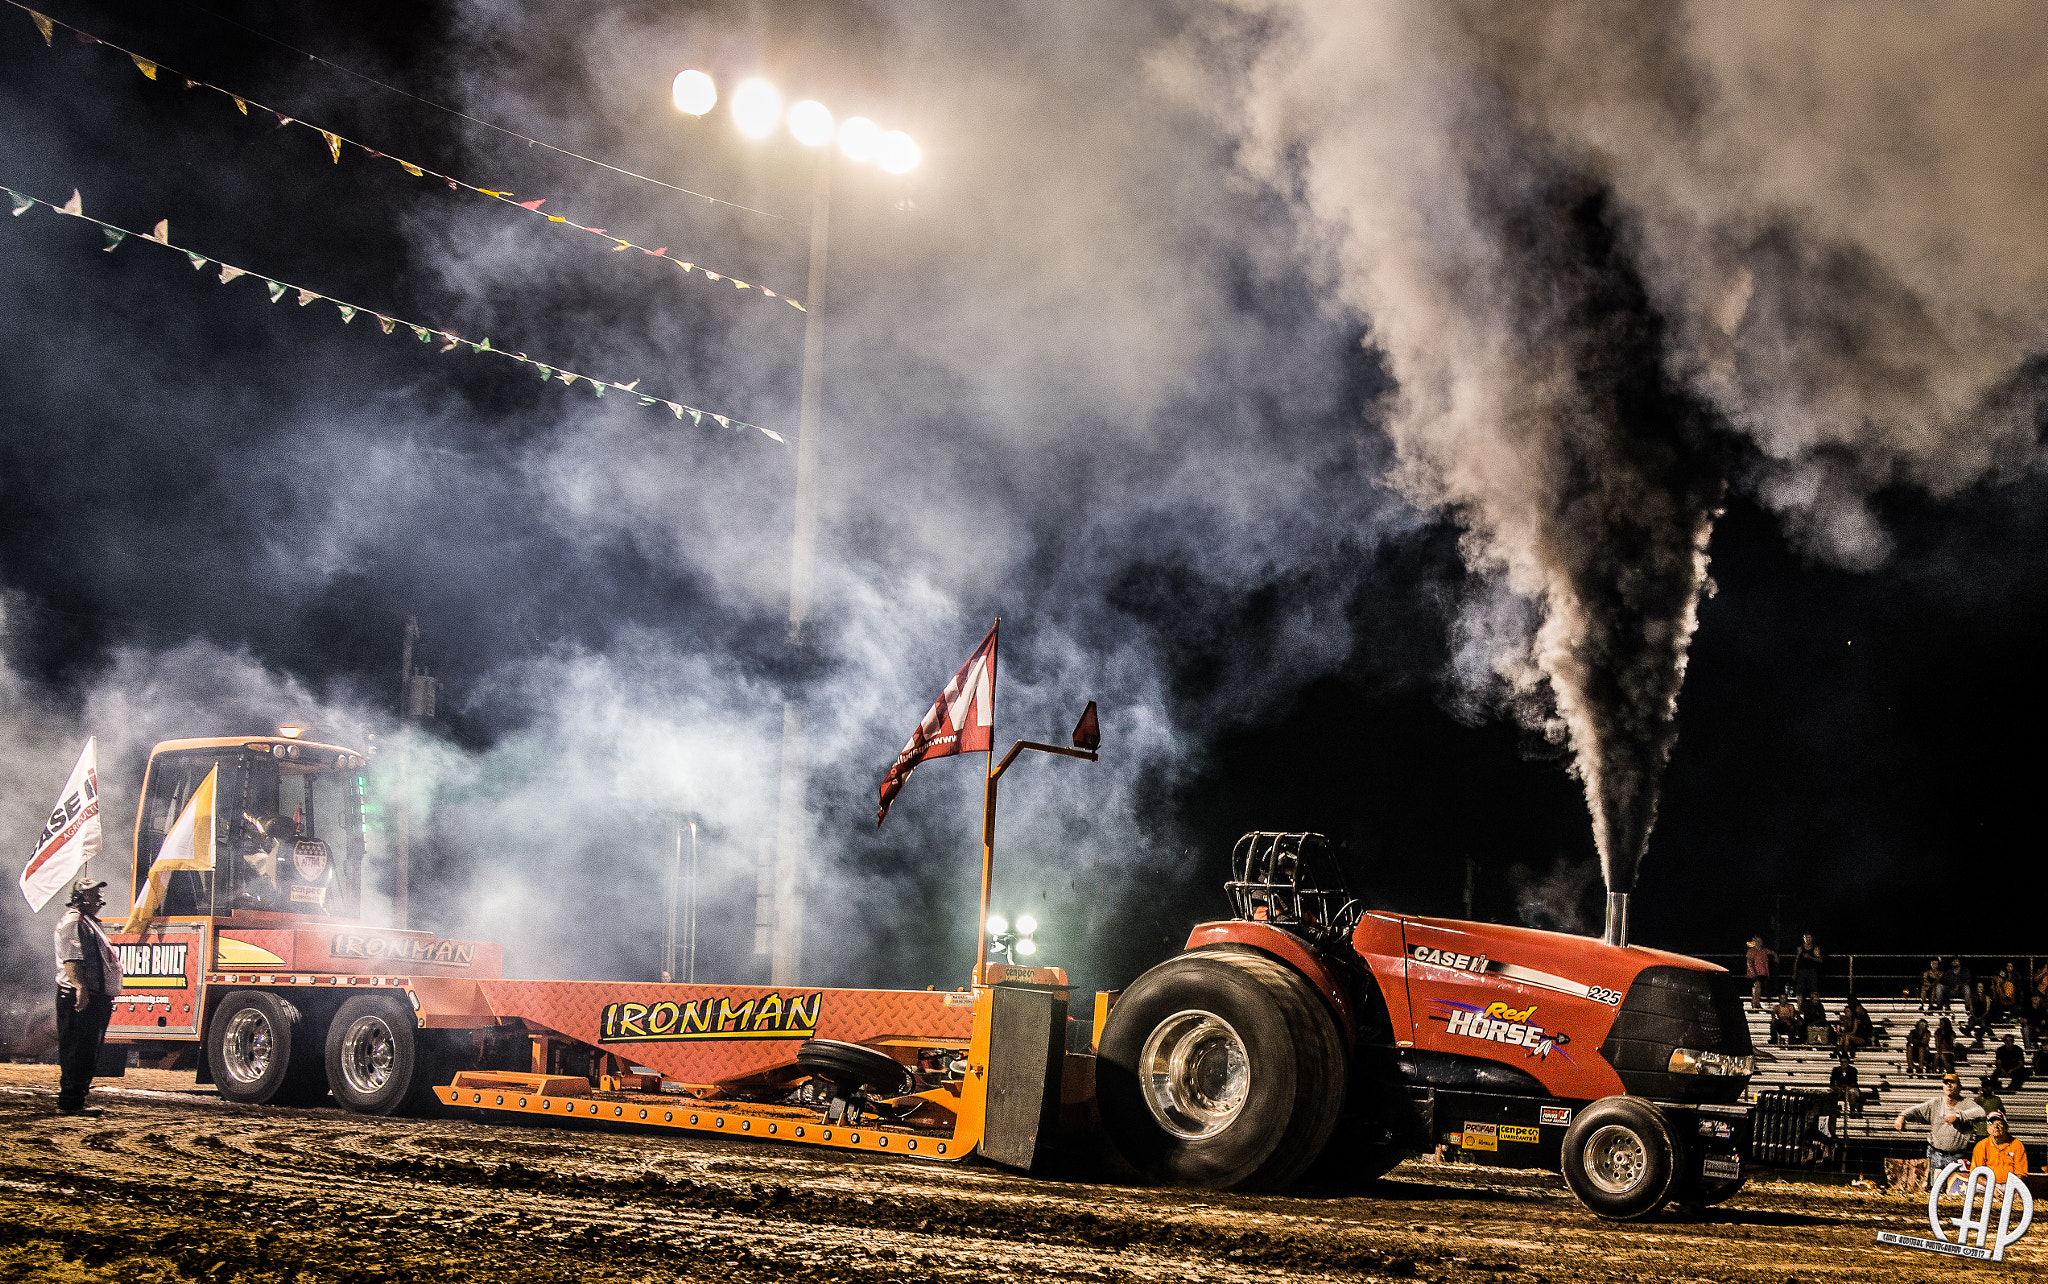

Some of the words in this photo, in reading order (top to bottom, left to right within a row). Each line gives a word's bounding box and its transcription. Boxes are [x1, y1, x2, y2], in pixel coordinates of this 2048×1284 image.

[30, 790, 81, 860] ASE
[152, 945, 187, 975] BUILT
[332, 934, 475, 963] IRONMAN
[1413, 946, 1471, 970] CASE
[1587, 986, 1622, 1006] 225
[601, 992, 822, 1037] IRONMAN
[1485, 1001, 1538, 1023] Red
[1446, 1009, 1546, 1048] HORSE
